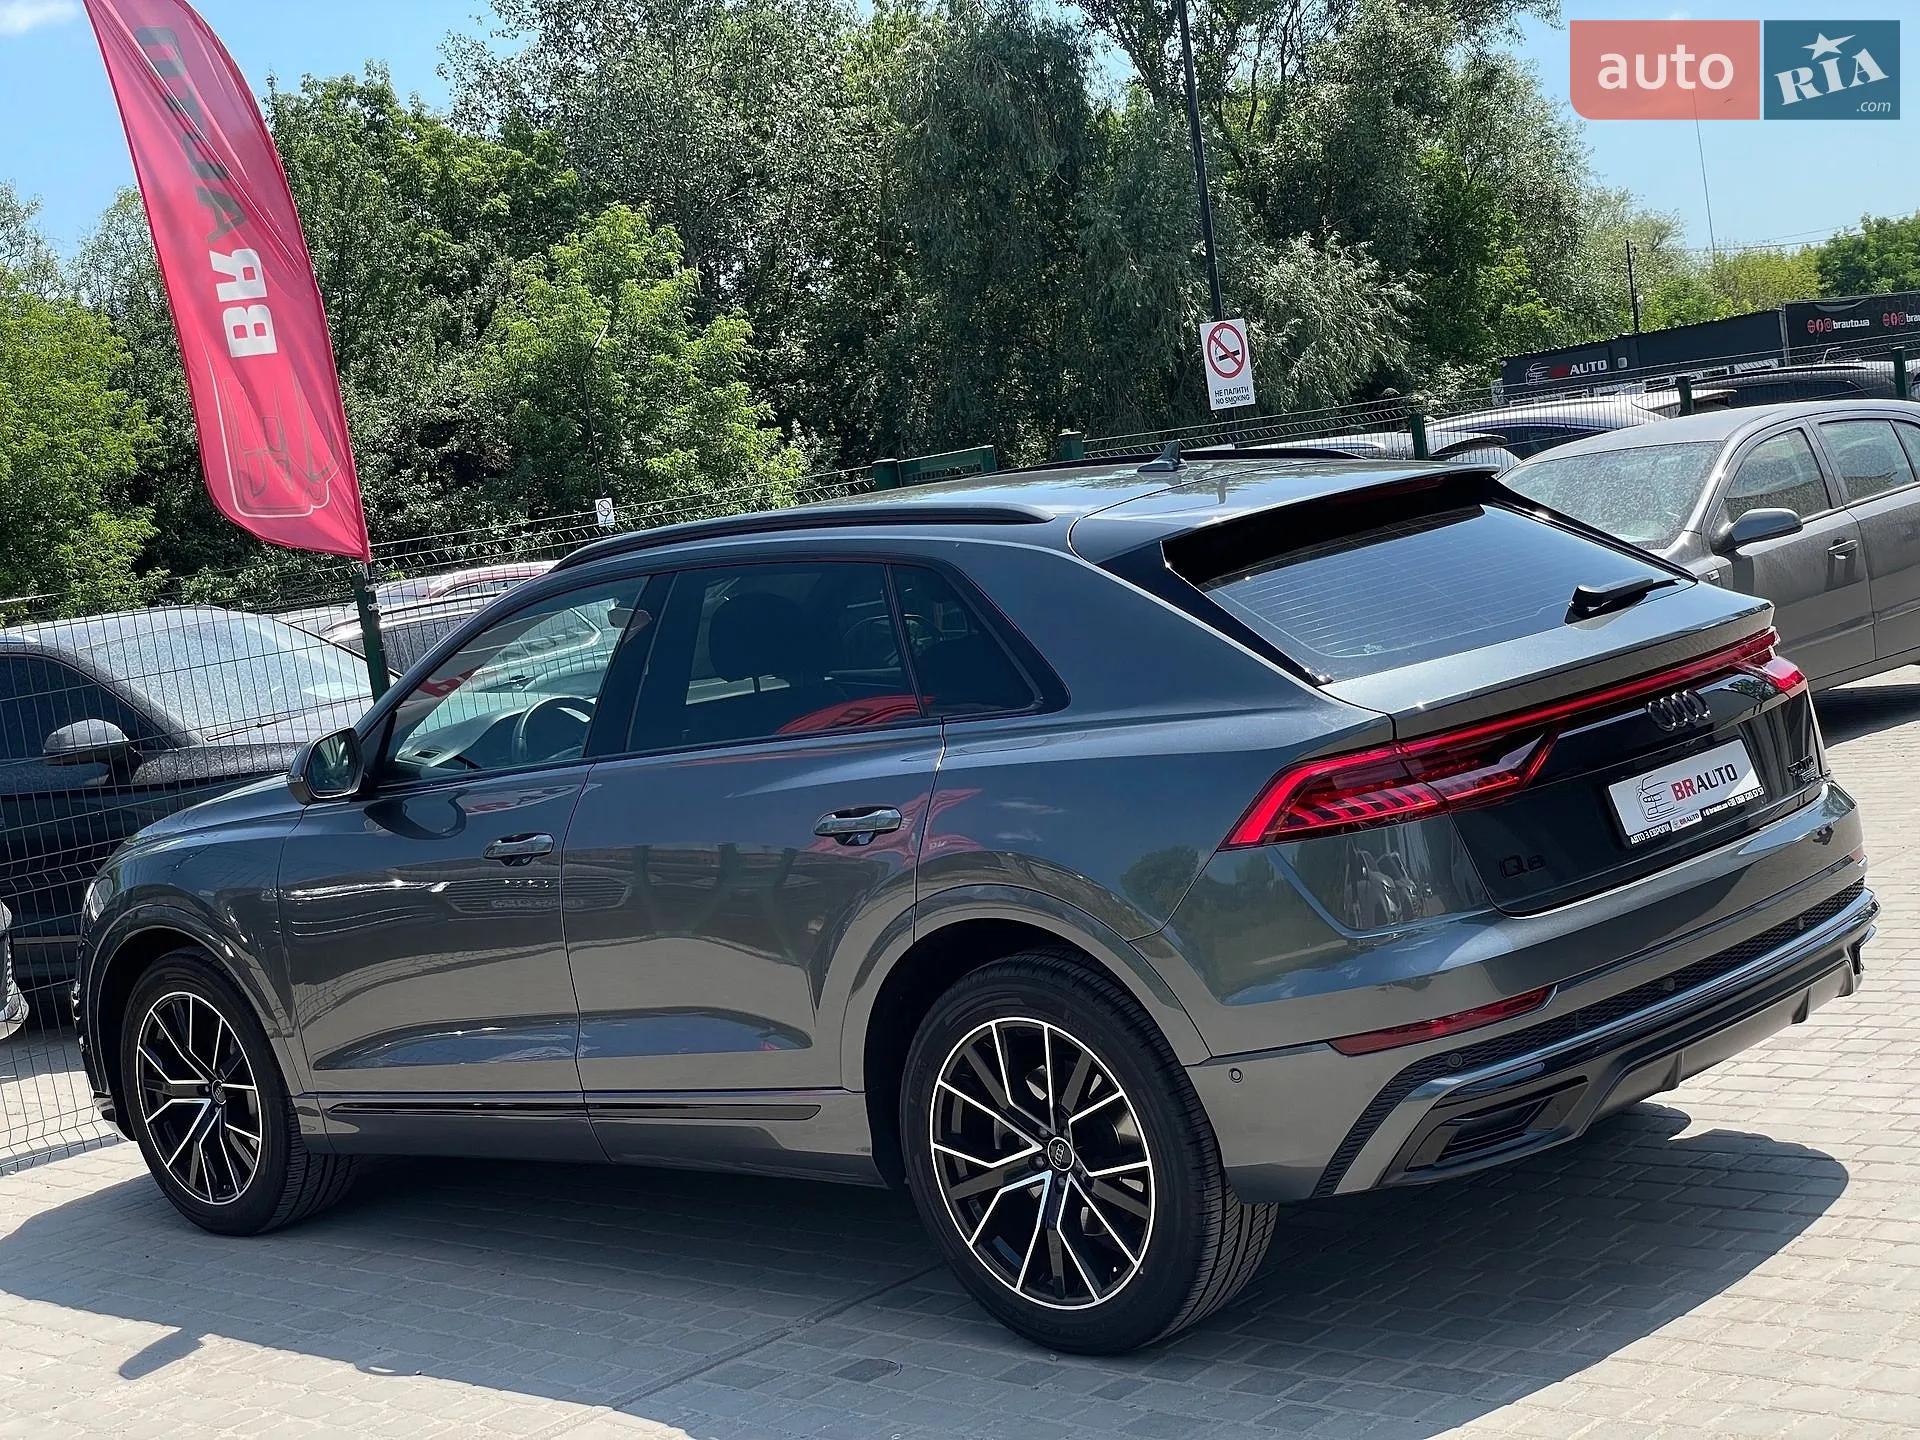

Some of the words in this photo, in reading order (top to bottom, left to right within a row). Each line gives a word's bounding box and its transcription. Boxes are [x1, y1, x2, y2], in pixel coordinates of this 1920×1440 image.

[1832, 319, 1870, 329] brauto.ua
[1215, 389, 1222, 397] НЕ
[1223, 386, 1249, 396] ПАЛИТИ
[1225, 394, 1250, 404] SMOKING
[1671, 763, 1738, 801] BRAUTO
